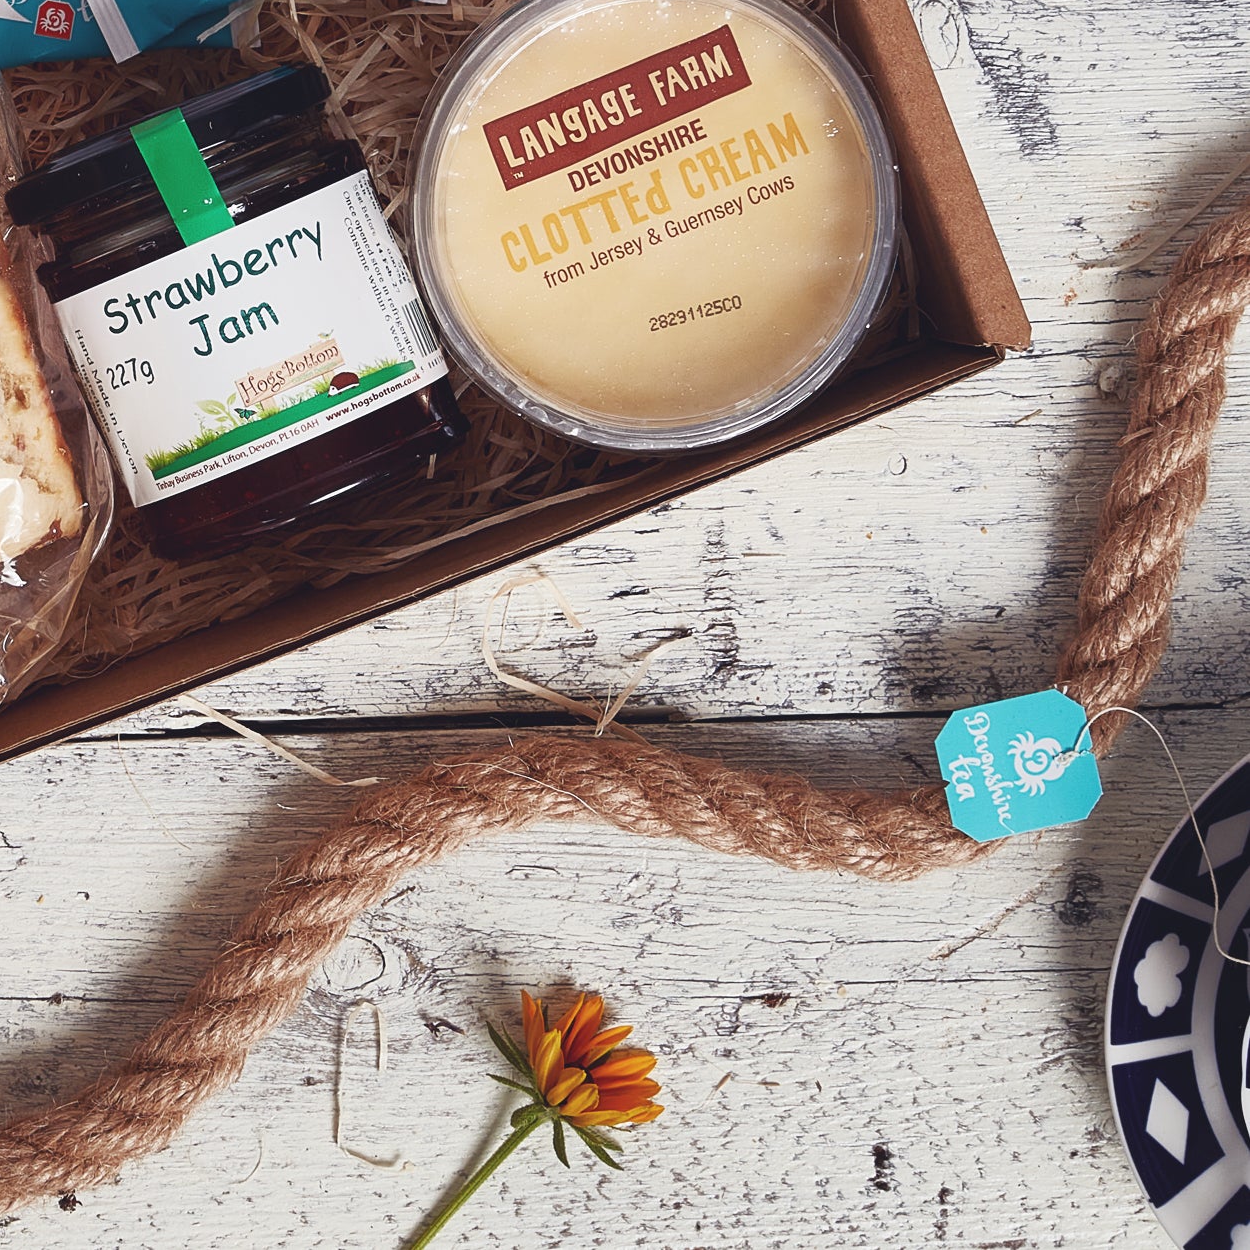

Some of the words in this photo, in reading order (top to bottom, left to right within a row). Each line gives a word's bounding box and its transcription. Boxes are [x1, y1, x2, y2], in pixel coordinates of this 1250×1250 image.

[648, 44, 734, 106] FARM
[567, 118, 708, 192] DEVONSHIRE
[679, 112, 810, 199] CREAM
[104, 220, 322, 334] Strawberry
[343, 190, 357, 217] Once
[355, 219, 375, 256] opened
[371, 258, 385, 283] store
[382, 286, 390, 296] in
[387, 298, 416, 356] refrigerator
[543, 261, 586, 289] from
[590, 236, 645, 271] Jersey
[647, 227, 663, 245] &
[665, 196, 744, 238] Guernsey
[746, 174, 796, 205] Cows
[189, 302, 280, 357] Jam
[343, 217, 370, 272] Consume
[368, 275, 387, 312] within
[384, 314, 392, 322] 6
[389, 325, 408, 362] weeks
[74, 329, 95, 366] Hand
[91, 369, 112, 408] Made
[109, 412, 118, 426] in
[116, 430, 139, 475] Devon
[106, 357, 155, 390] 227g
[174, 468, 204, 485] Business
[203, 461, 223, 473] Park,
[222, 450, 249, 466] Lifton,
[248, 437, 279, 455] Devon,
[278, 427, 301, 442] PL16
[325, 373, 421, 422] www.hogsbottom.co.uk
[948, 754, 981, 803] tea
[963, 711, 1015, 834] Devonshire
